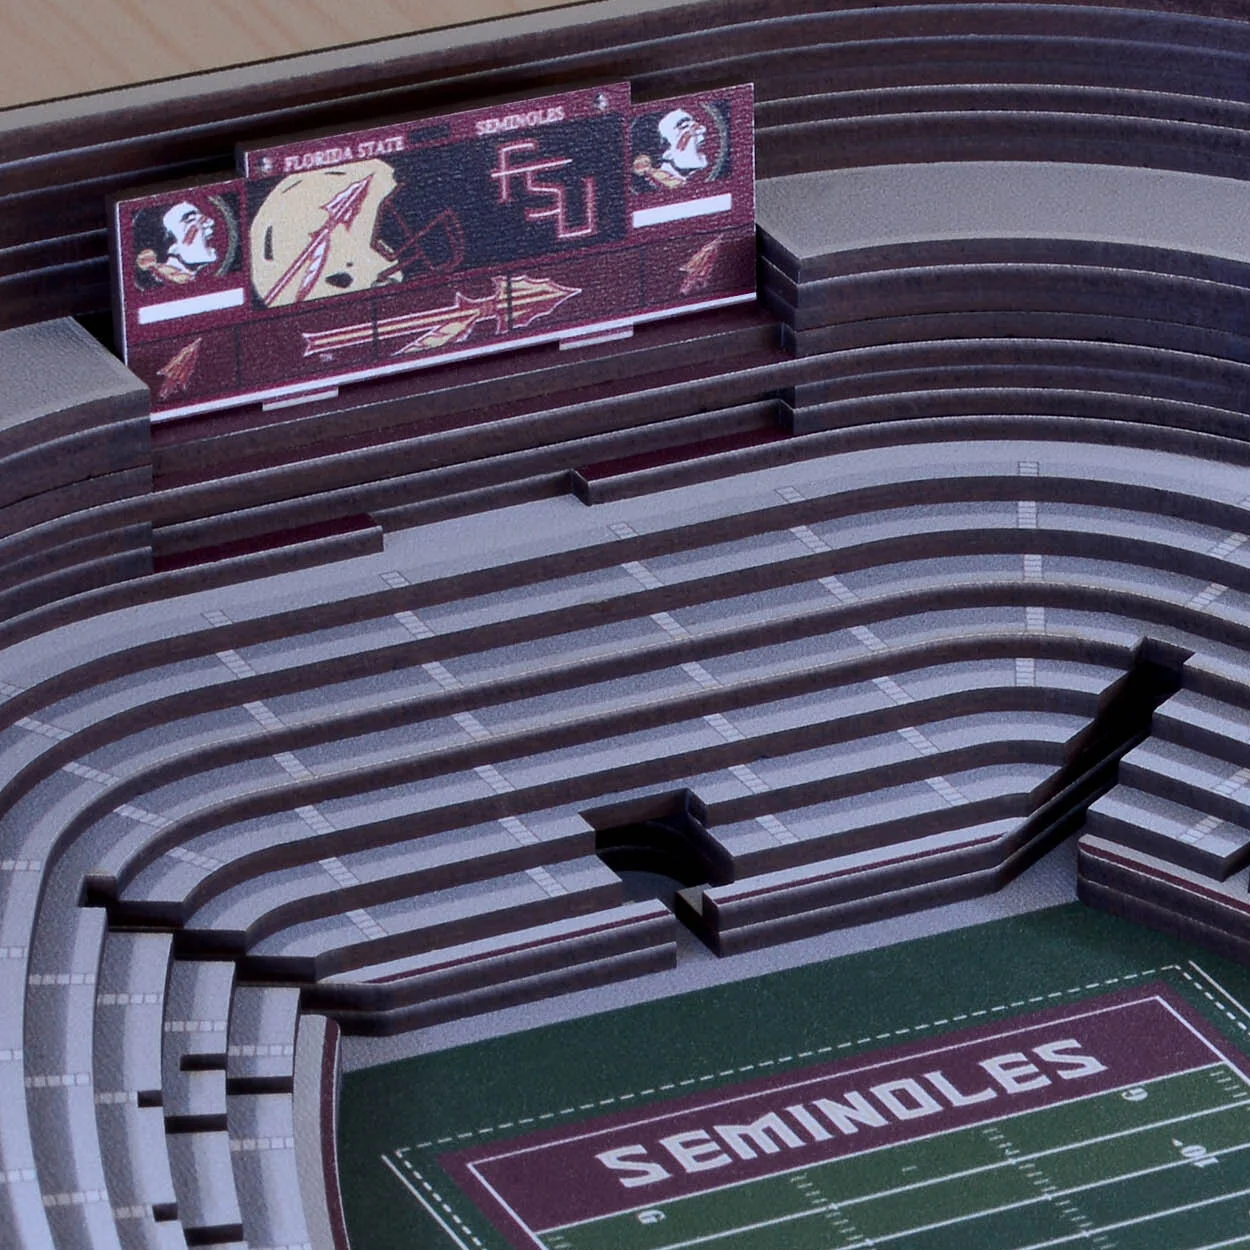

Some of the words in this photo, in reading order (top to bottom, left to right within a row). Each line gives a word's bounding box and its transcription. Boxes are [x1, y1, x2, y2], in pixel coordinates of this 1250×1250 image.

[476, 107, 565, 135] SEMINOLES
[283, 149, 352, 172] FLORIDA
[358, 136, 404, 158] STATE
[593, 1038, 1108, 1188] SEMINOLES
